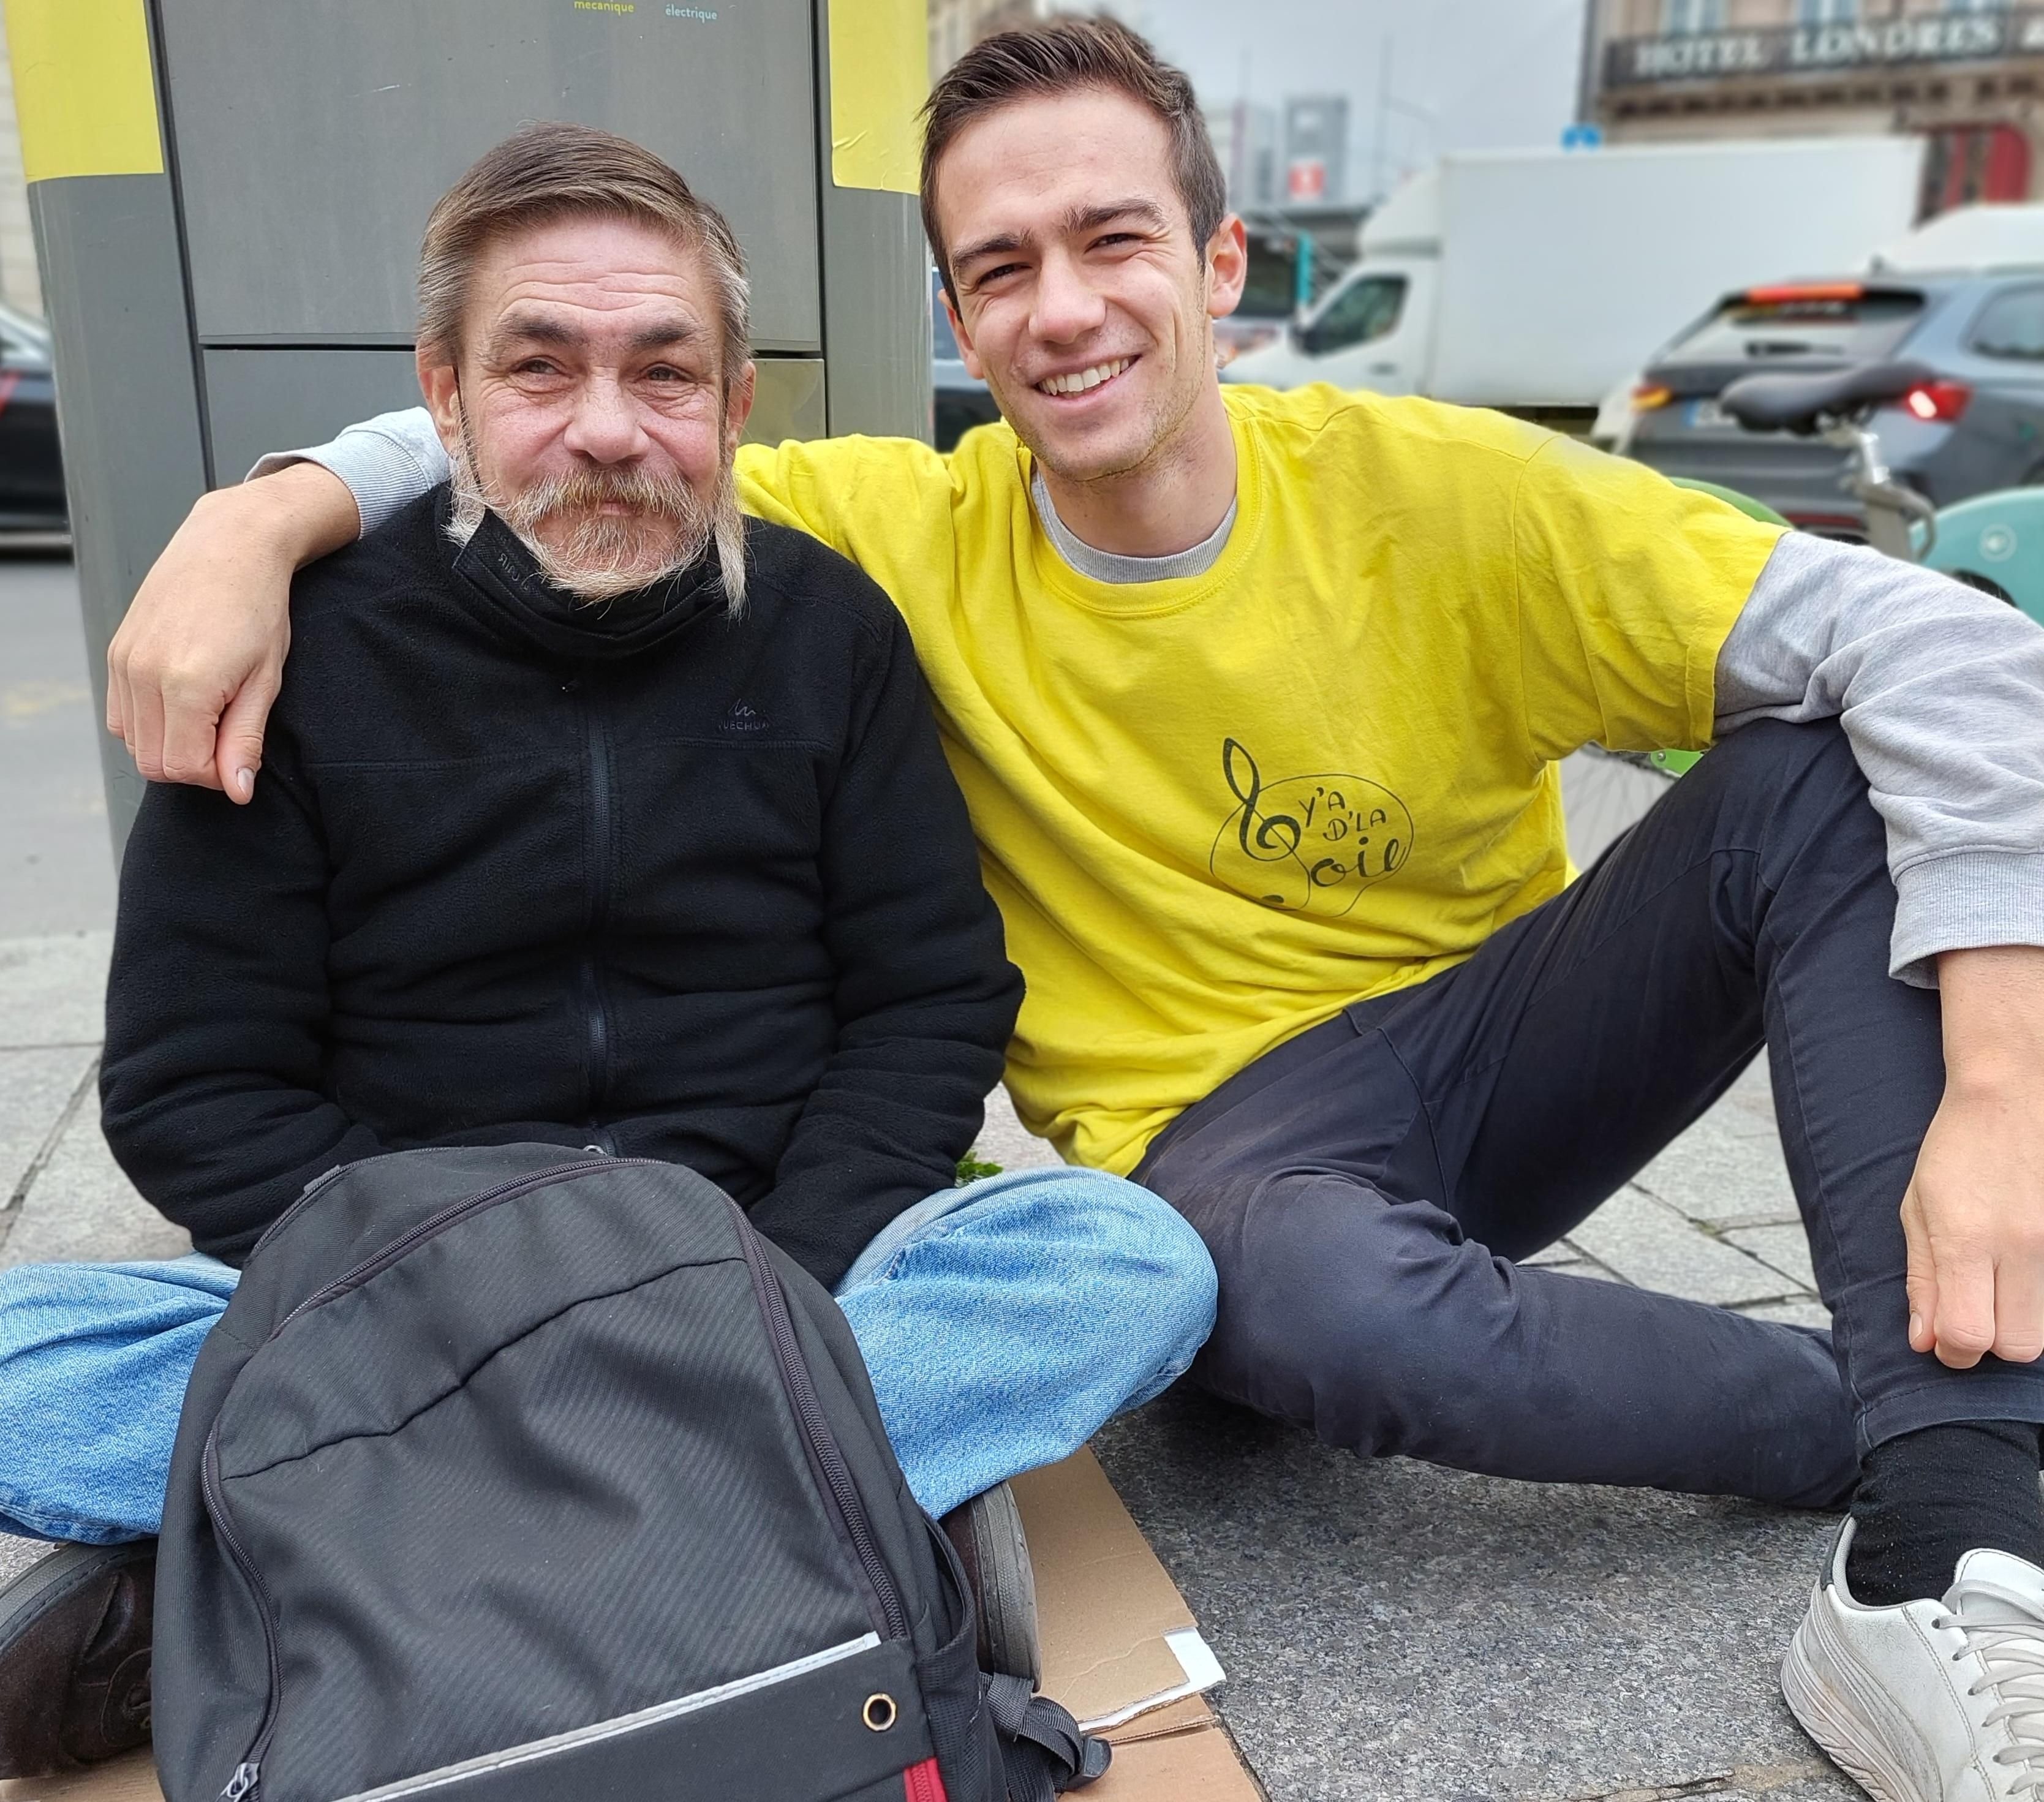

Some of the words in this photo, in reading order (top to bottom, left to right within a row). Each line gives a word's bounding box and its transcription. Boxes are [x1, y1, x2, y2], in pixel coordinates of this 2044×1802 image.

[665, 3, 717, 24] électrique
[1791, 17, 1999, 63] LONDRES
[1322, 809, 1387, 841] D'LA
